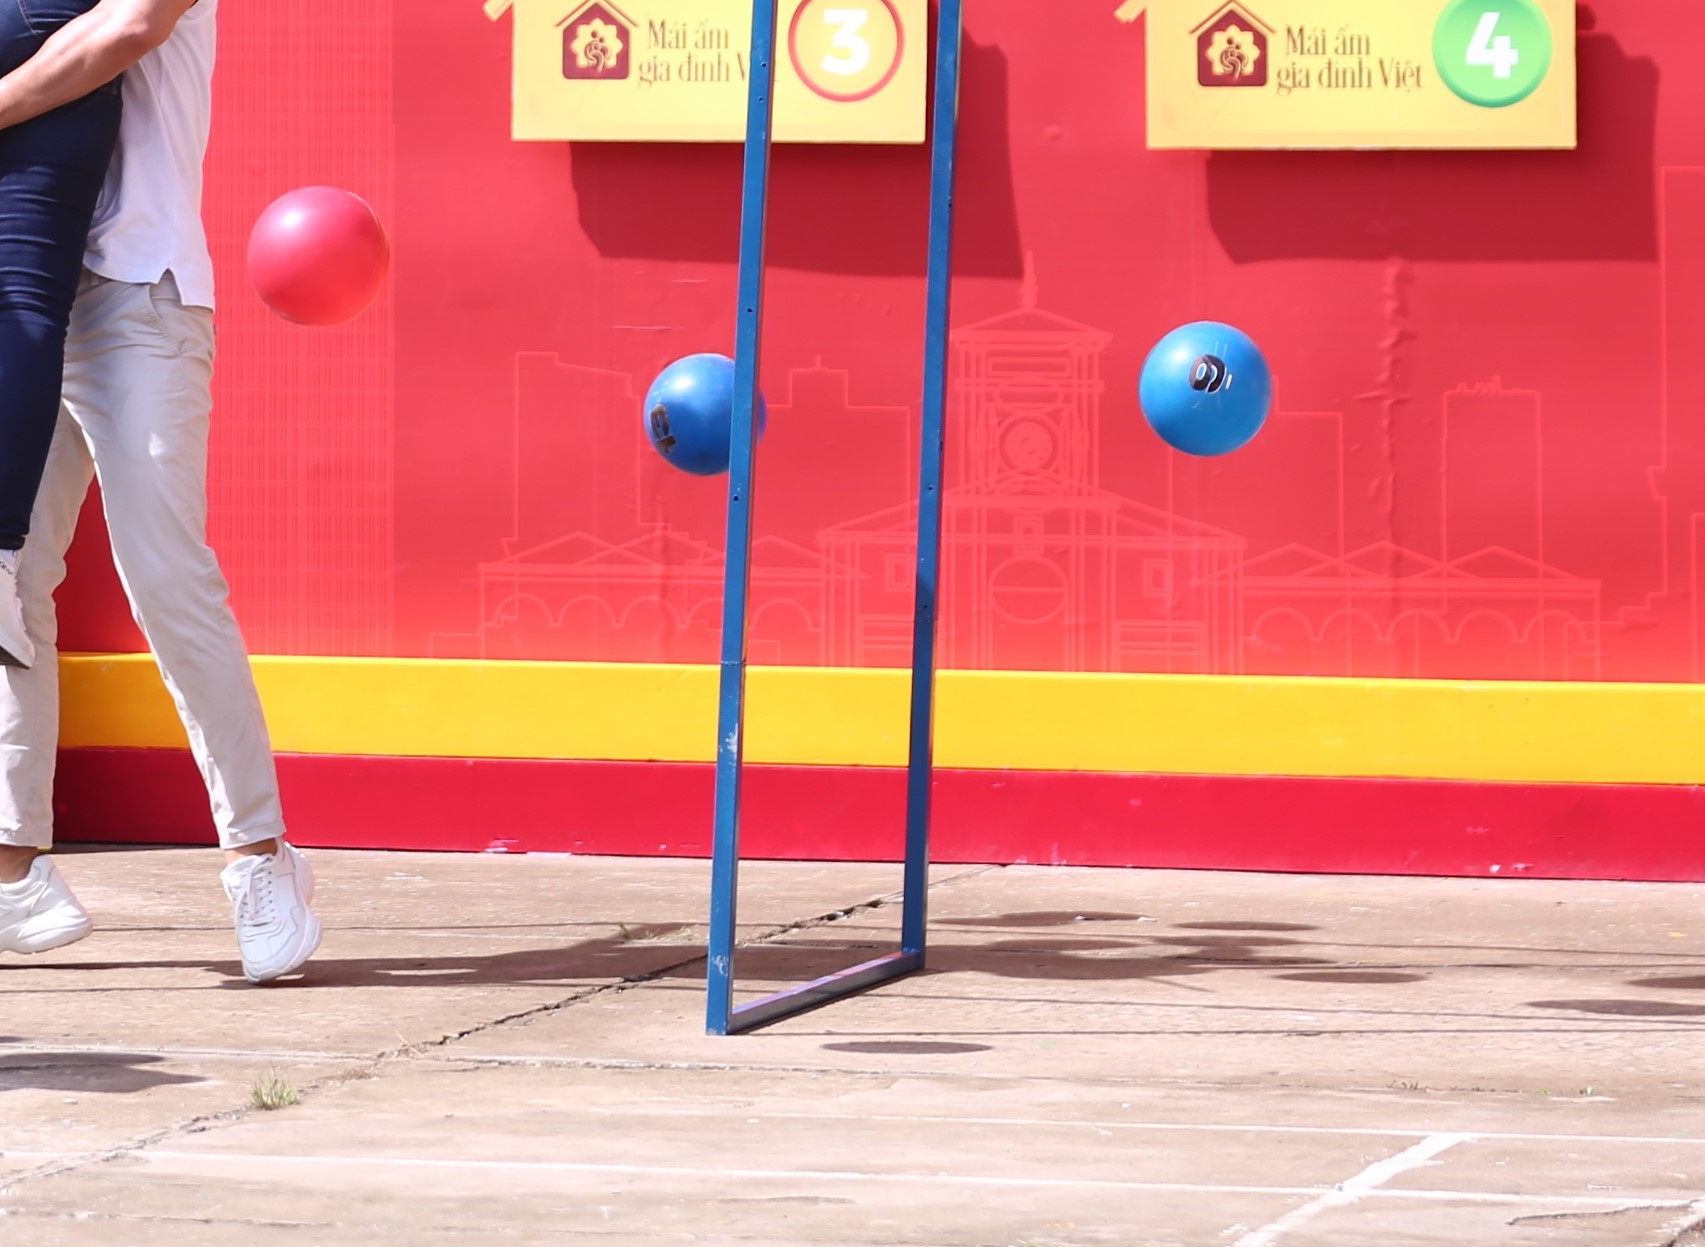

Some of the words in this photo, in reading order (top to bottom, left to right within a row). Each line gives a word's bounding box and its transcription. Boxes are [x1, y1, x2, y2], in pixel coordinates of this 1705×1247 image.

[648, 18, 687, 49] Mái
[694, 18, 729, 49] ấm
[821, 8, 870, 75] 3
[1285, 24, 1326, 56] Mái
[1333, 23, 1371, 56] ấm
[1465, 11, 1519, 80] 4
[638, 55, 671, 90] gia
[678, 52, 730, 82] đình
[1276, 59, 1311, 96] gia
[1318, 56, 1373, 89] đình
[1379, 56, 1424, 92] Việt
